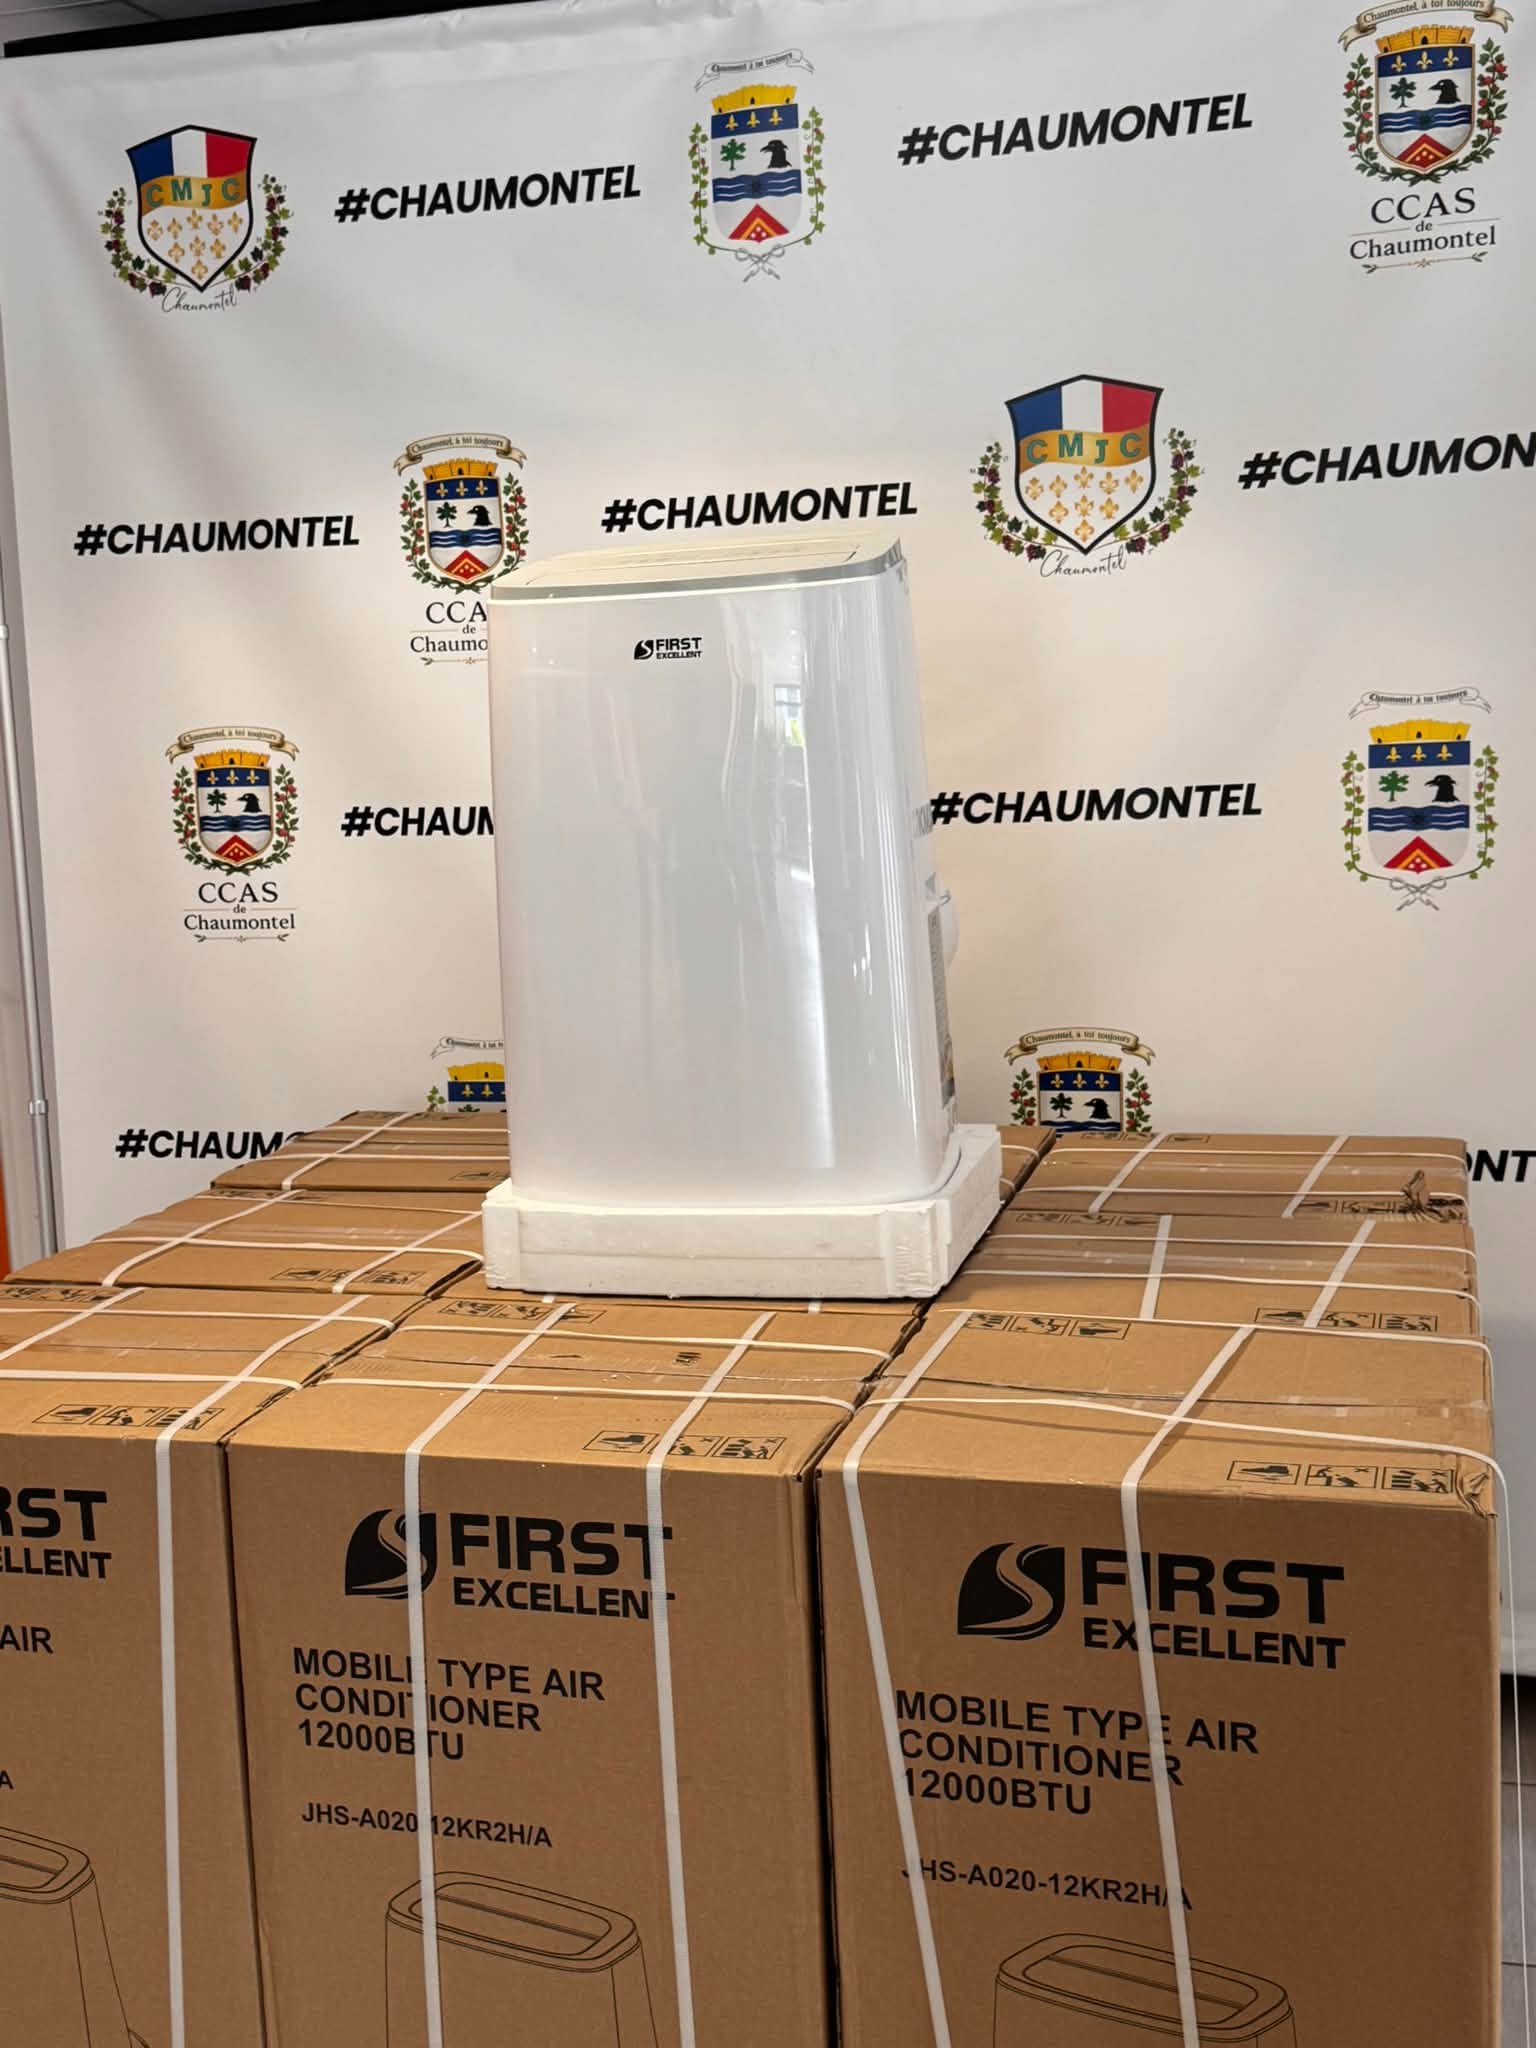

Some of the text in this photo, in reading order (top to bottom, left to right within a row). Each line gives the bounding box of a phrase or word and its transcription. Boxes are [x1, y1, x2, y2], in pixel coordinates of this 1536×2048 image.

[897, 92, 1253, 166] #CHAUMONTEL
[334, 164, 641, 223] #CHAUMONTEL
[1370, 186, 1476, 224] CCAS
[1349, 225, 1496, 260] Chaumontel
[1415, 220, 1433, 232] de
[161, 283, 238, 313] Chaumontel
[1238, 431, 1536, 490] #CHAUMON
[601, 481, 918, 533] #CHAUMONTEL
[73, 515, 360, 556] #CHAUMONTEL
[1040, 544, 1128, 578] Chaumontel
[425, 600, 487, 624] CCA
[462, 624, 477, 634] de
[410, 635, 489, 653] Chaumo
[655, 637, 703, 651] FIRST
[655, 650, 703, 660] EXCELLENT
[929, 783, 1262, 825] #CHAUMONTEL
[198, 881, 279, 903] CCAS
[233, 904, 246, 913] de
[184, 913, 296, 930] Chaumontel
[115, 1129, 304, 1159] #CHAUM
[1465, 1149, 1536, 1182] NT
[450, 1512, 672, 1580] FIRST
[1081, 1547, 1345, 1625] FIRST
[0, 1624, 54, 1654] AIR
[1083, 1617, 1346, 1669] EXCELLENT
[293, 1647, 605, 1701] MOBIL TYPE AIR
[295, 1683, 541, 1732] CONDIIONER
[896, 1690, 1051, 1733] MOBILE
[1185, 1718, 1259, 1754] AIR
[299, 1719, 464, 1760] 12000BTU
[899, 1728, 1184, 1786] CONDITIONER
[905, 1767, 1092, 1815] 12000BTU
[302, 1803, 552, 1847] JHS-A02012KR2H/A
